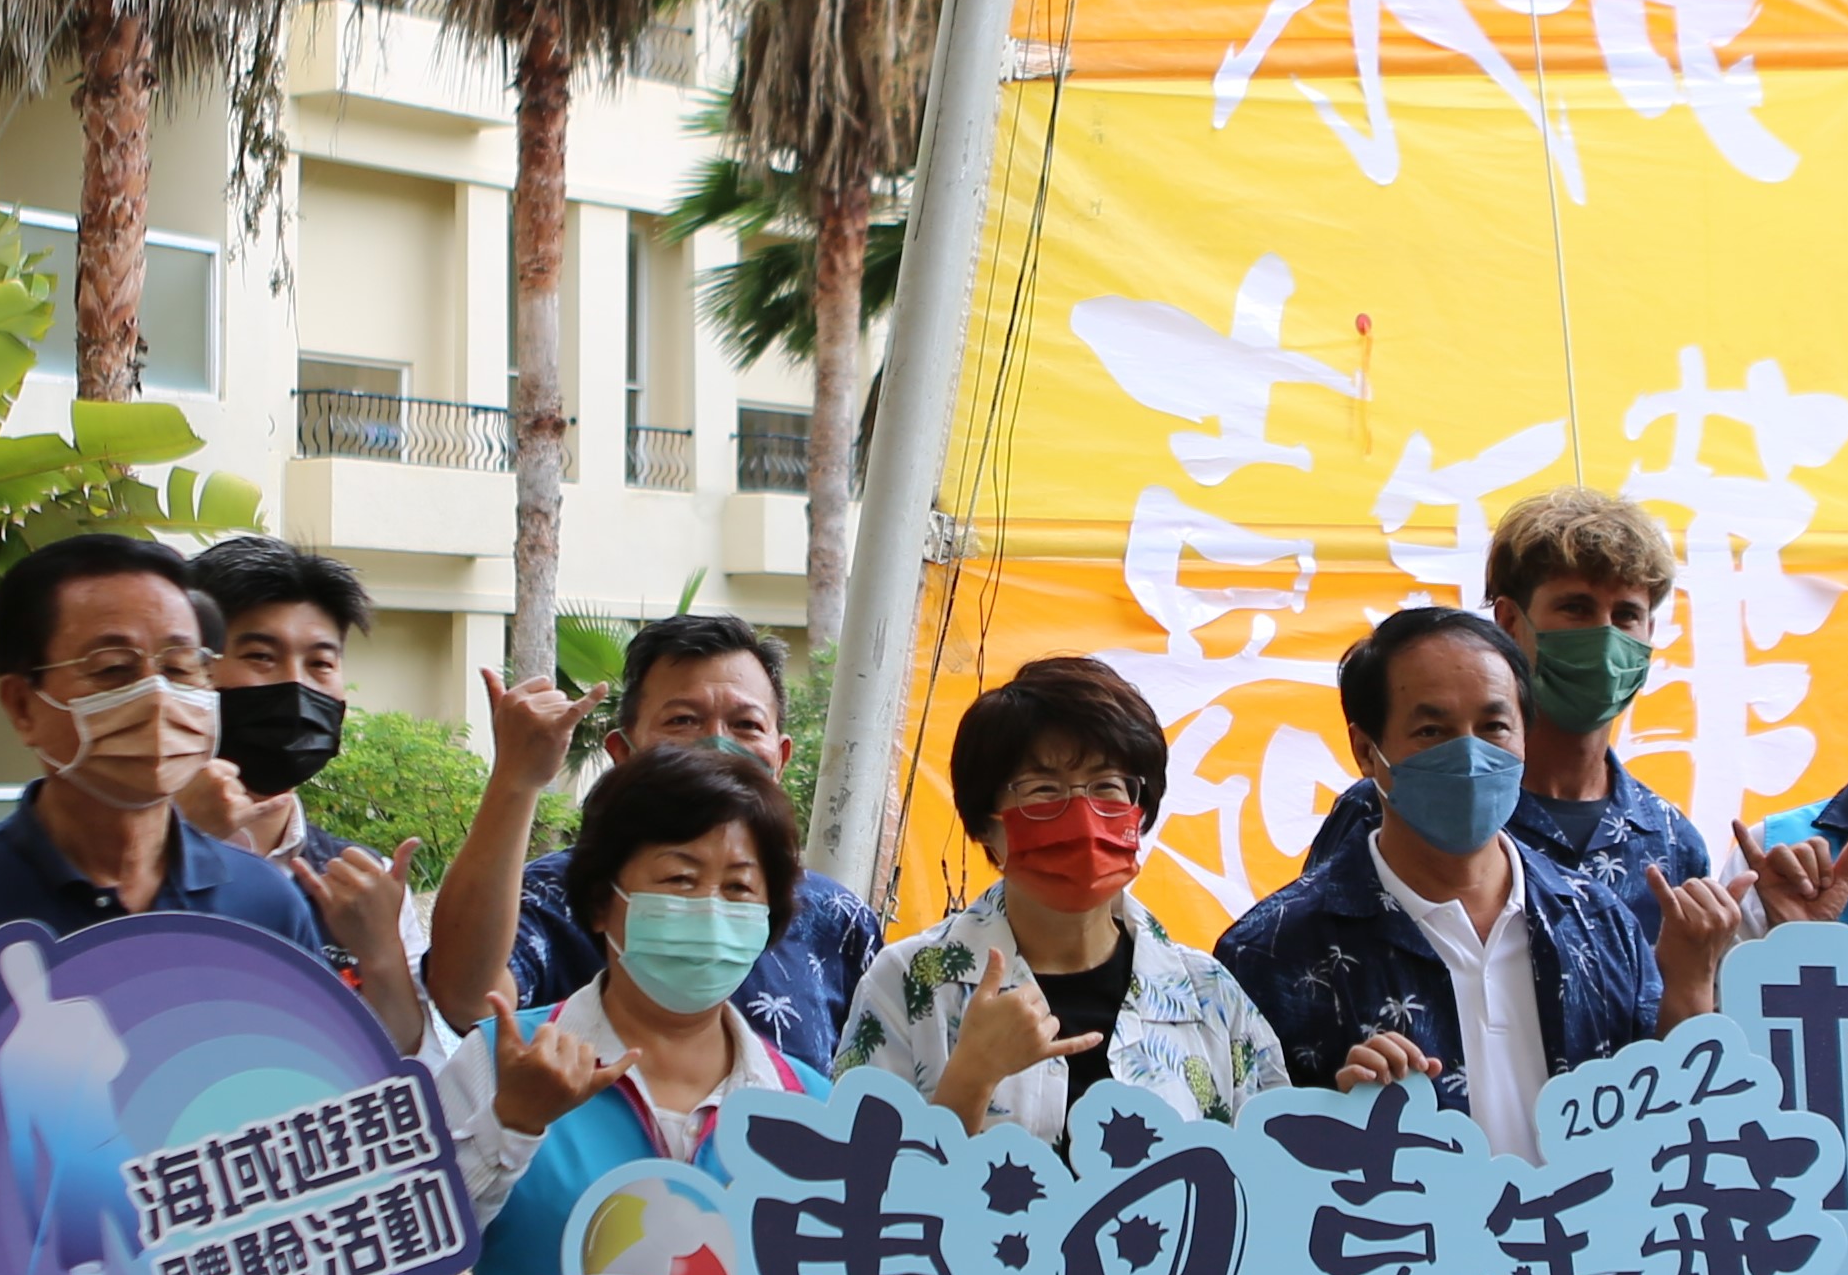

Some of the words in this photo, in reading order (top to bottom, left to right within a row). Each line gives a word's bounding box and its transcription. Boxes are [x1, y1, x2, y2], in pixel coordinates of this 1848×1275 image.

[1560, 1037, 1755, 1141] 2022
[126, 1083, 433, 1243] 海域遊憩
